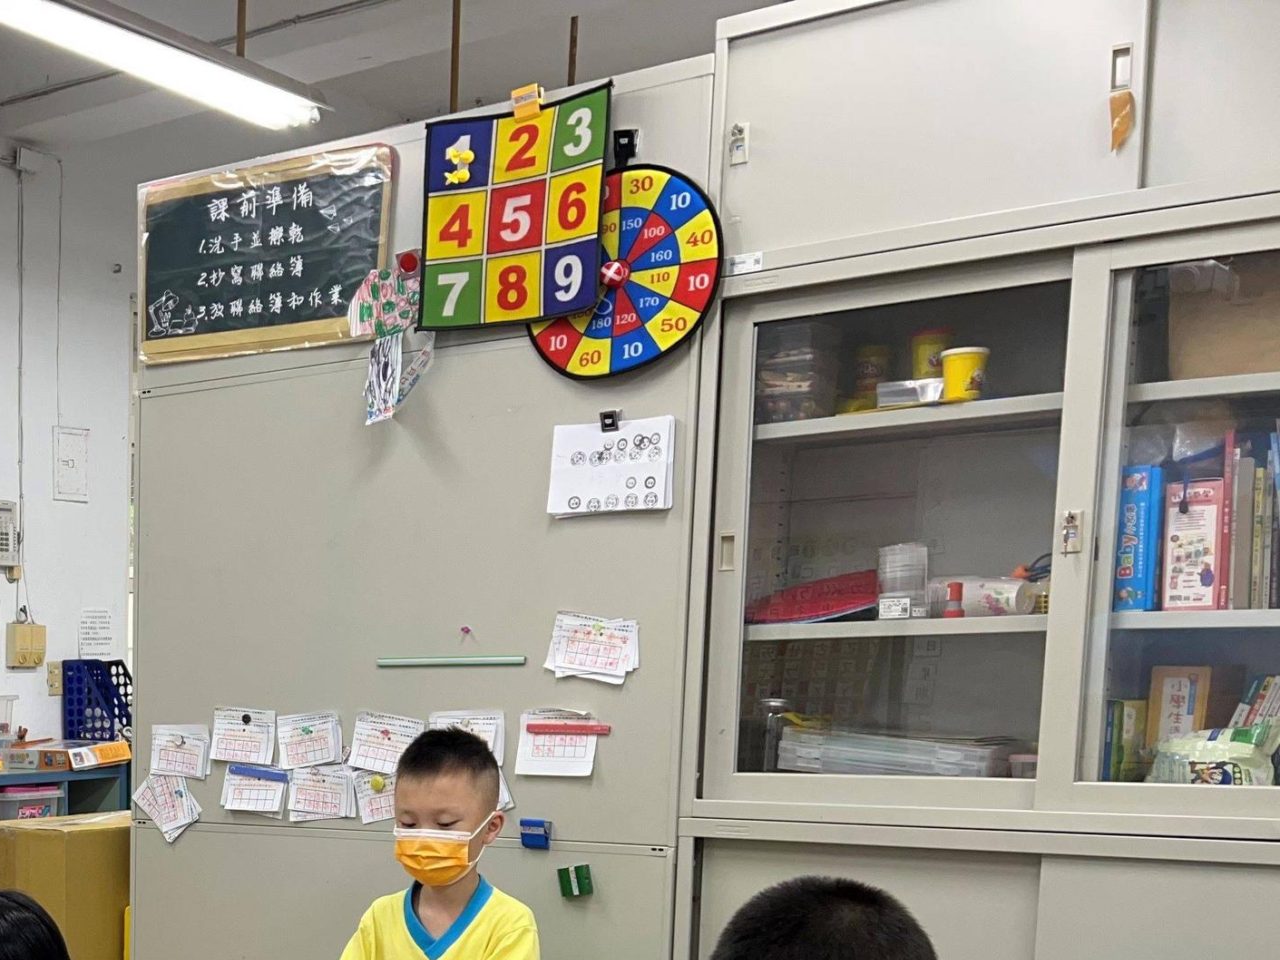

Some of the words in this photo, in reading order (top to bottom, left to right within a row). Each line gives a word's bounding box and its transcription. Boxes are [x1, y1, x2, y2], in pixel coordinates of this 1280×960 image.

[562, 108, 592, 156] 3
[445, 135, 471, 178] 1
[505, 124, 539, 172] 2
[629, 175, 653, 194] 30
[207, 182, 313, 222] 課前準備
[558, 181, 587, 230] 6
[669, 192, 690, 211] 10
[439, 204, 472, 248] 4
[499, 195, 532, 242] 5
[622, 217, 642, 231] 150
[643, 226, 665, 239] 100
[686, 229, 713, 247] 40
[651, 249, 672, 262] 160
[554, 255, 583, 302] 9
[650, 271, 670, 284] 110
[688, 274, 709, 291] 10
[437, 272, 469, 317] 7
[496, 265, 528, 310] 8
[639, 296, 659, 308] 170
[592, 316, 612, 330] 180
[615, 312, 636, 326] 120
[660, 317, 688, 332] 50
[549, 335, 568, 350] 10
[622, 342, 643, 359] 10
[578, 350, 601, 367] 60
